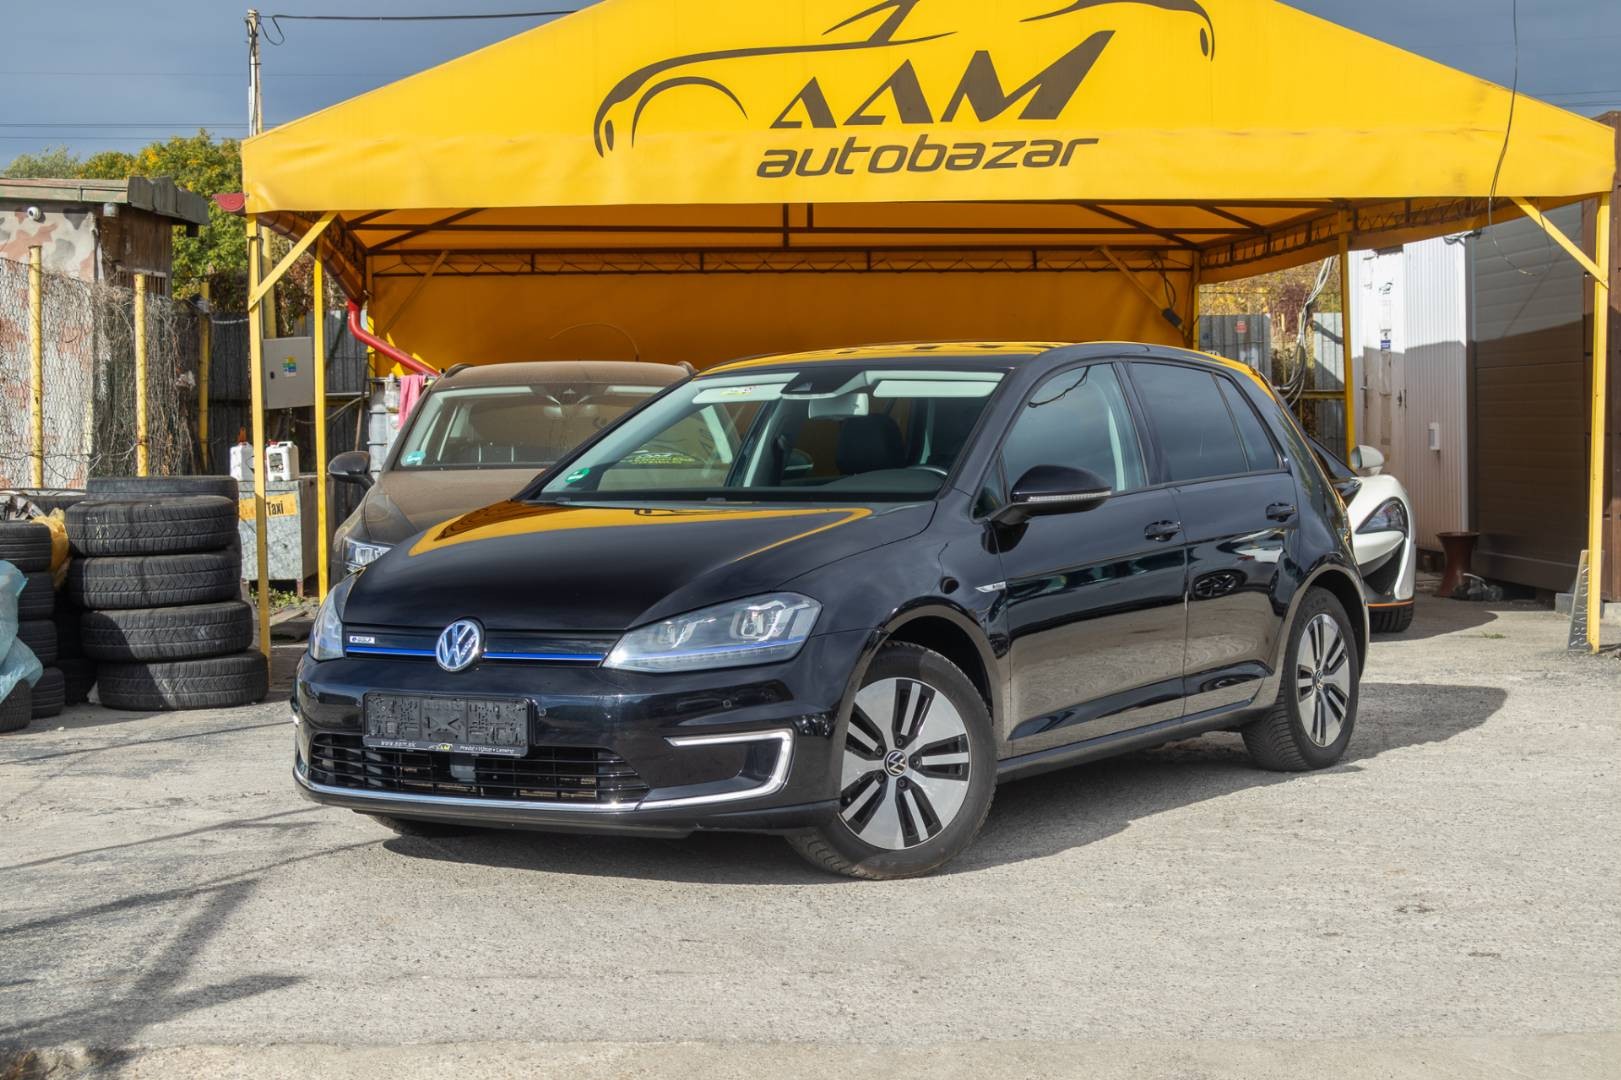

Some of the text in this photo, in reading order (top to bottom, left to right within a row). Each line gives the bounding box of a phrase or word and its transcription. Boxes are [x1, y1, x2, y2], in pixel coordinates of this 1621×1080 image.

[769, 30, 1116, 129] AAM
[756, 134, 1099, 178] autobazar
[266, 500, 284, 516] Taxi
